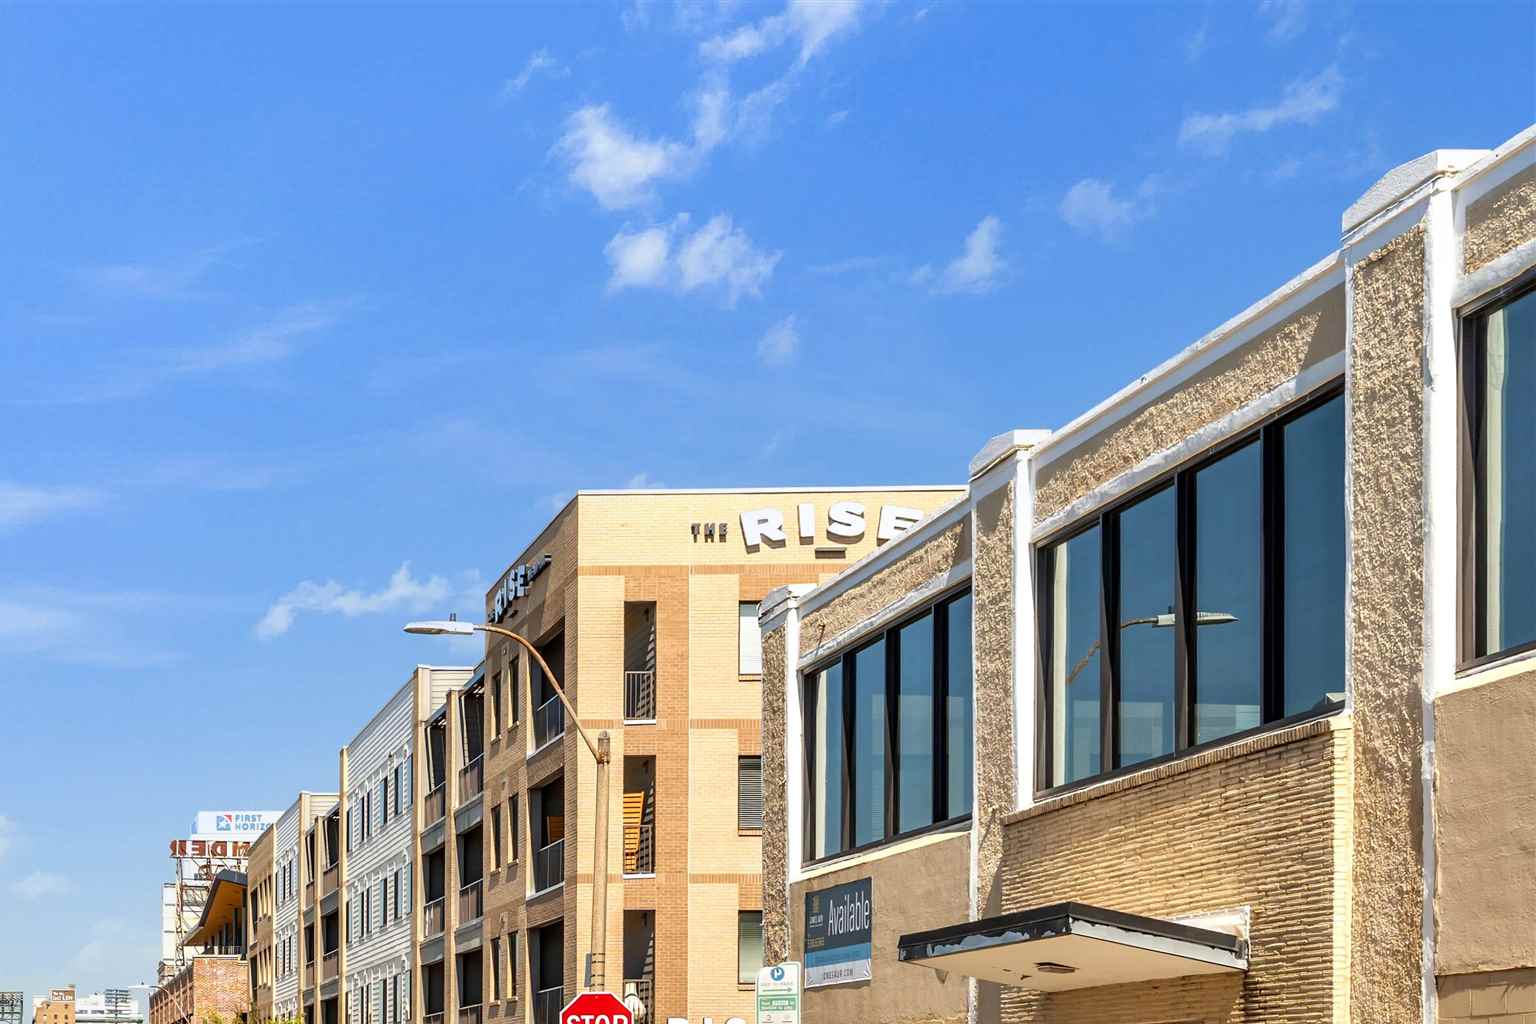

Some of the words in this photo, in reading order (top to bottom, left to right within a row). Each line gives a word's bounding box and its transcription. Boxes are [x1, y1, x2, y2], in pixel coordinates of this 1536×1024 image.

[691, 522, 728, 543] THE
[739, 501, 927, 554] RISE
[827, 890, 870, 936] Available
